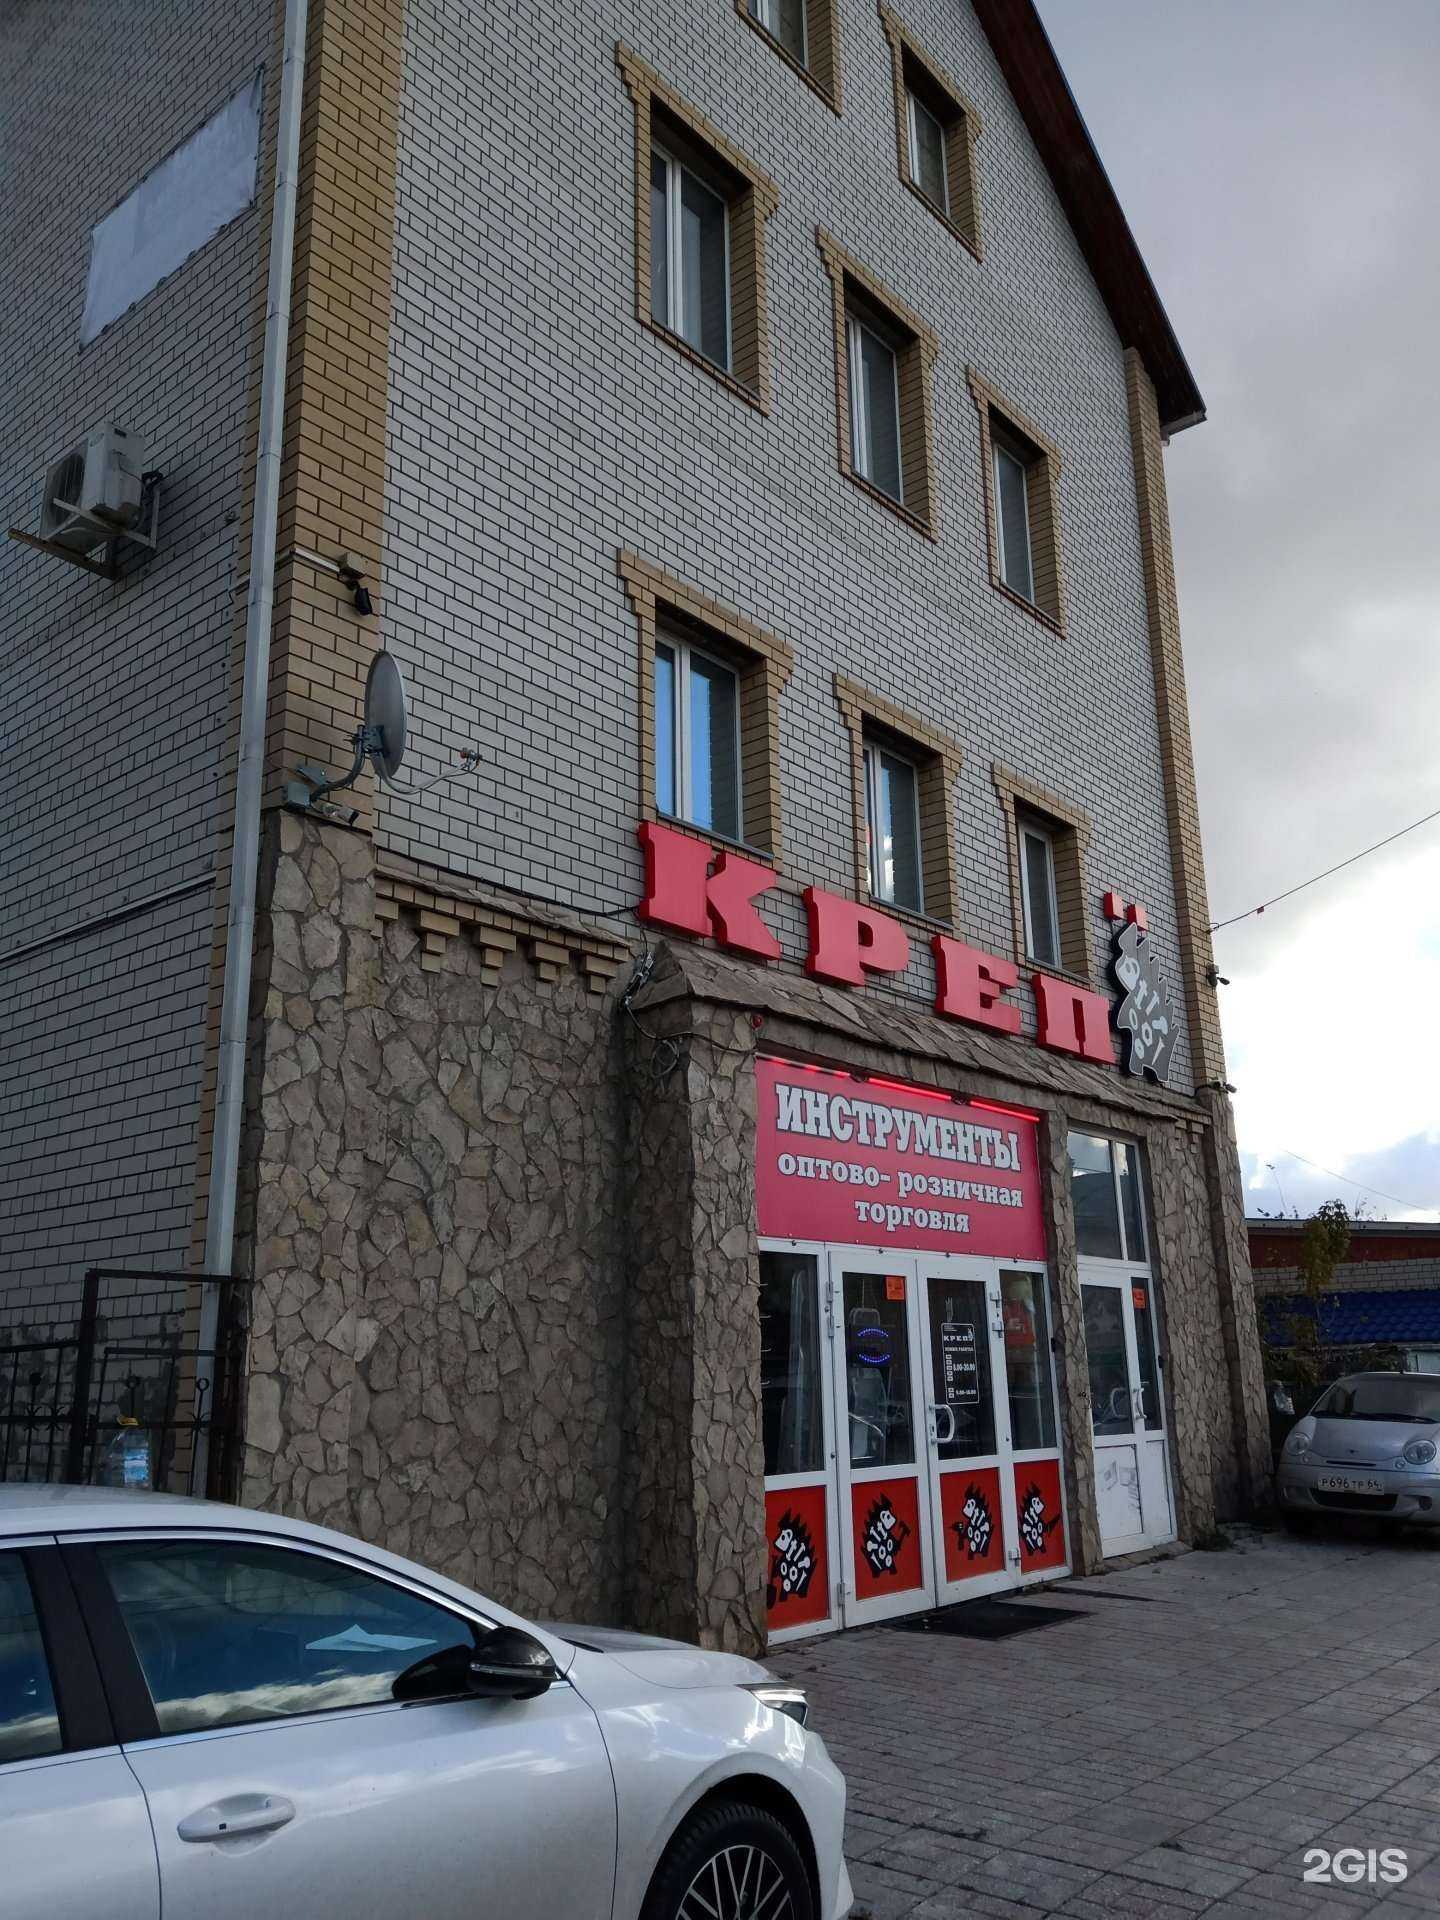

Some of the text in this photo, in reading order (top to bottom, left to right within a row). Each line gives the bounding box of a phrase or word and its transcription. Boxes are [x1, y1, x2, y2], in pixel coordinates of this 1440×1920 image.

[775, 1083, 1022, 1172] ИНСТРУМЕНТЫ
[898, 1171, 1023, 1208] розничная
[855, 1200, 970, 1233] торговля
